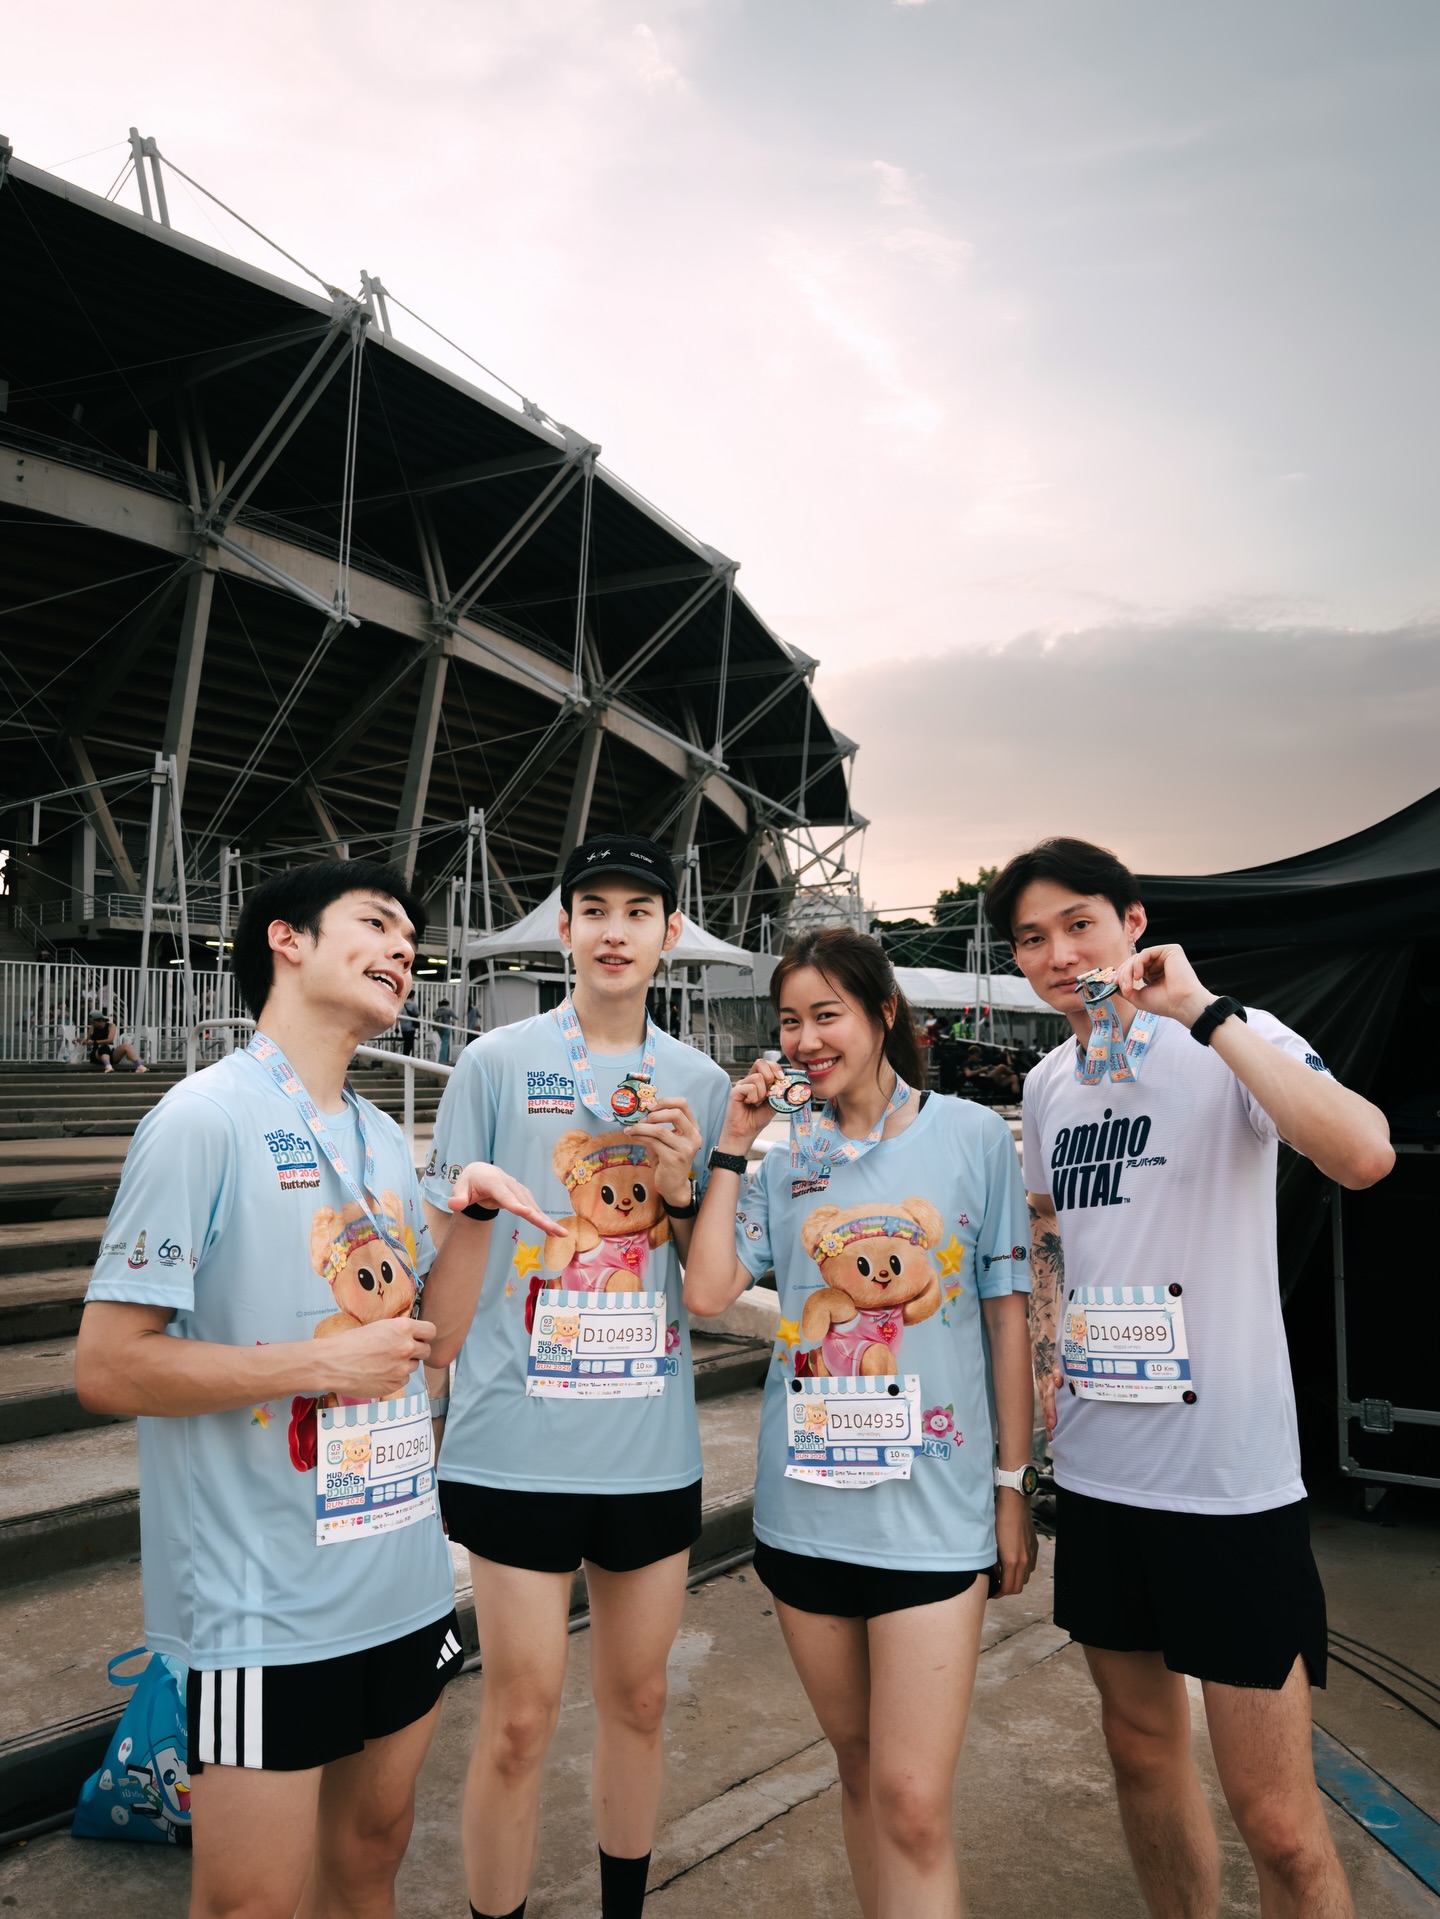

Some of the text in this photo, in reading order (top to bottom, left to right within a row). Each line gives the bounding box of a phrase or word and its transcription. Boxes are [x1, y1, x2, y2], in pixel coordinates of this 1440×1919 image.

[528, 1099, 575, 1108] RUN 2026
[528, 1107, 575, 1115] Butterbear
[264, 1129, 285, 1141] หมอ
[1051, 1108, 1152, 1169] amino
[1126, 1156, 1167, 1169] アミノバイタル
[280, 1179, 320, 1191] Buttrbear
[1052, 1161, 1124, 1212] VITAL
[158, 1238, 181, 1259] 60
[583, 1328, 652, 1343] D104933
[1090, 1325, 1167, 1341] D104989
[1151, 1364, 1162, 1372] 10
[831, 1413, 904, 1429] D104935
[331, 1444, 340, 1452] 03
[375, 1434, 429, 1465] B102961
[922, 1440, 949, 1458] KM
[326, 1471, 342, 1479] หมอ
[326, 1497, 365, 1509] RUN 2026
